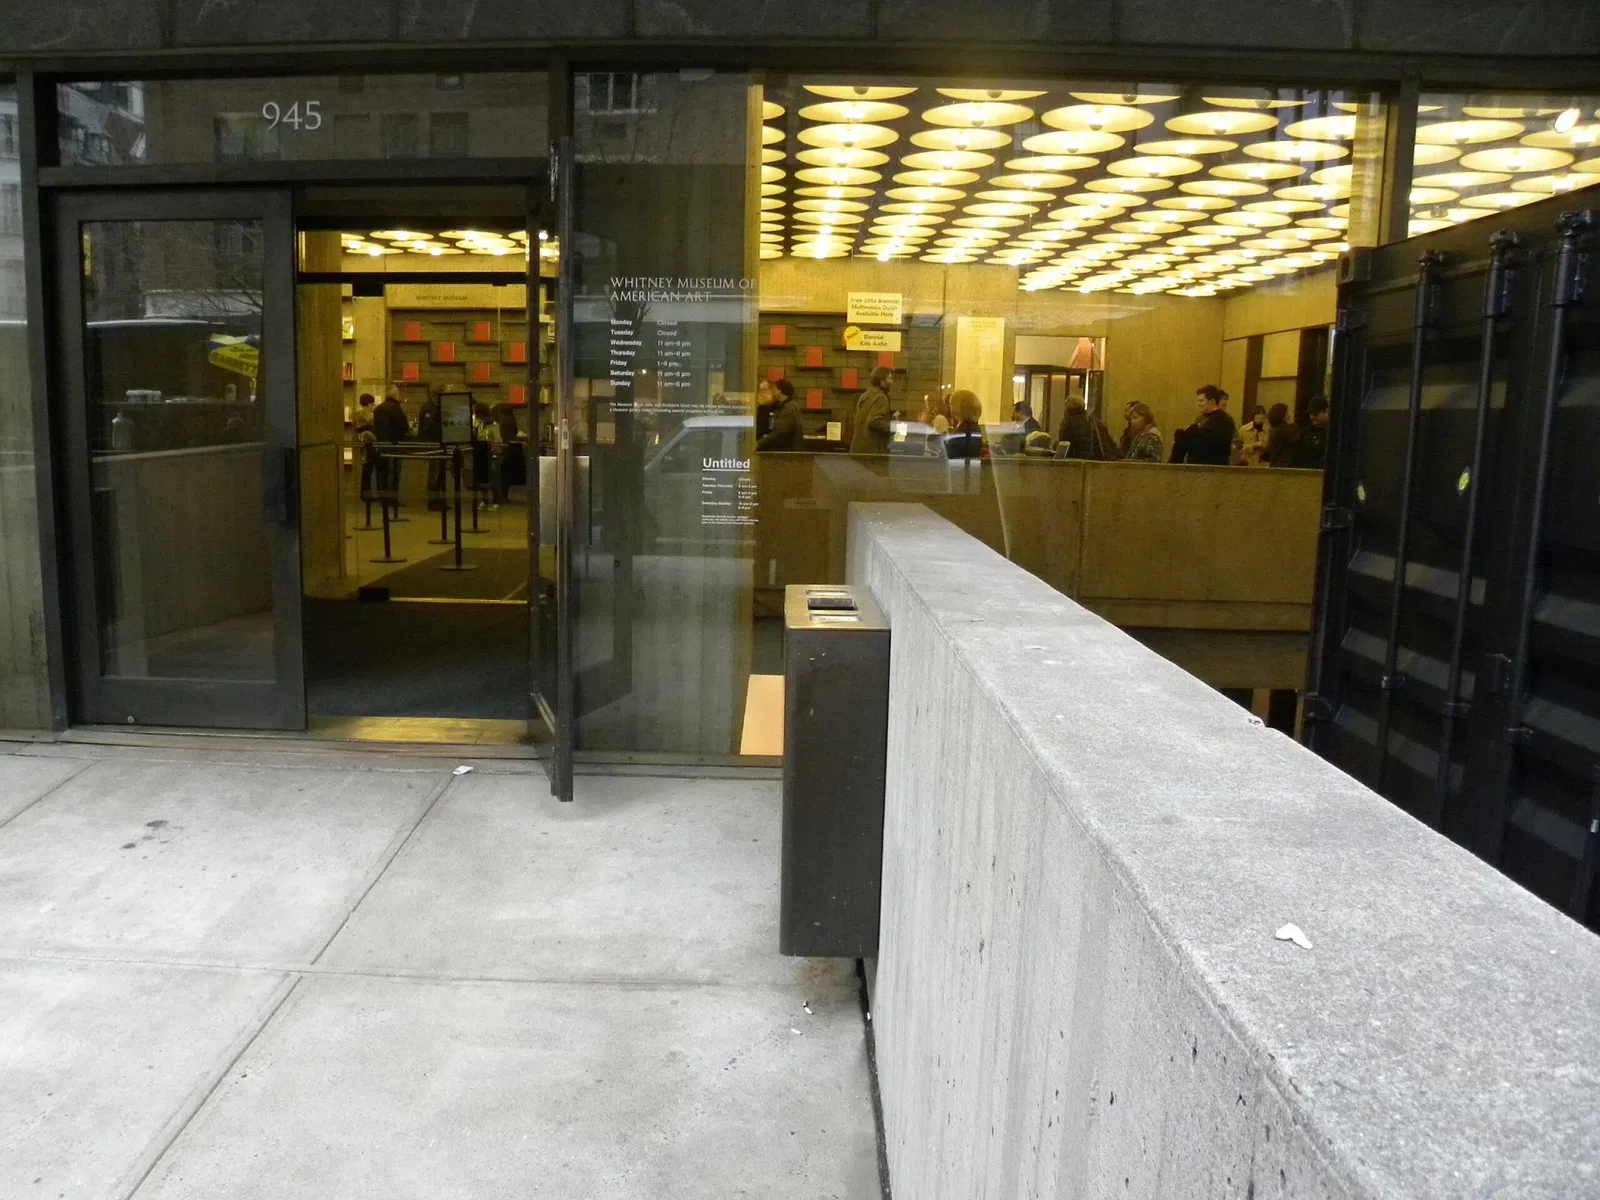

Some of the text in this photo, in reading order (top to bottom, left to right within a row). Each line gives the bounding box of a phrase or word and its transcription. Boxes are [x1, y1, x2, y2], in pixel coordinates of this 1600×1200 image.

[262, 100, 322, 131] 945
[610, 277, 756, 290] WHITNEY MUSEUM OF
[610, 291, 711, 302] AMERICAN ART
[703, 457, 750, 469] Untitled
